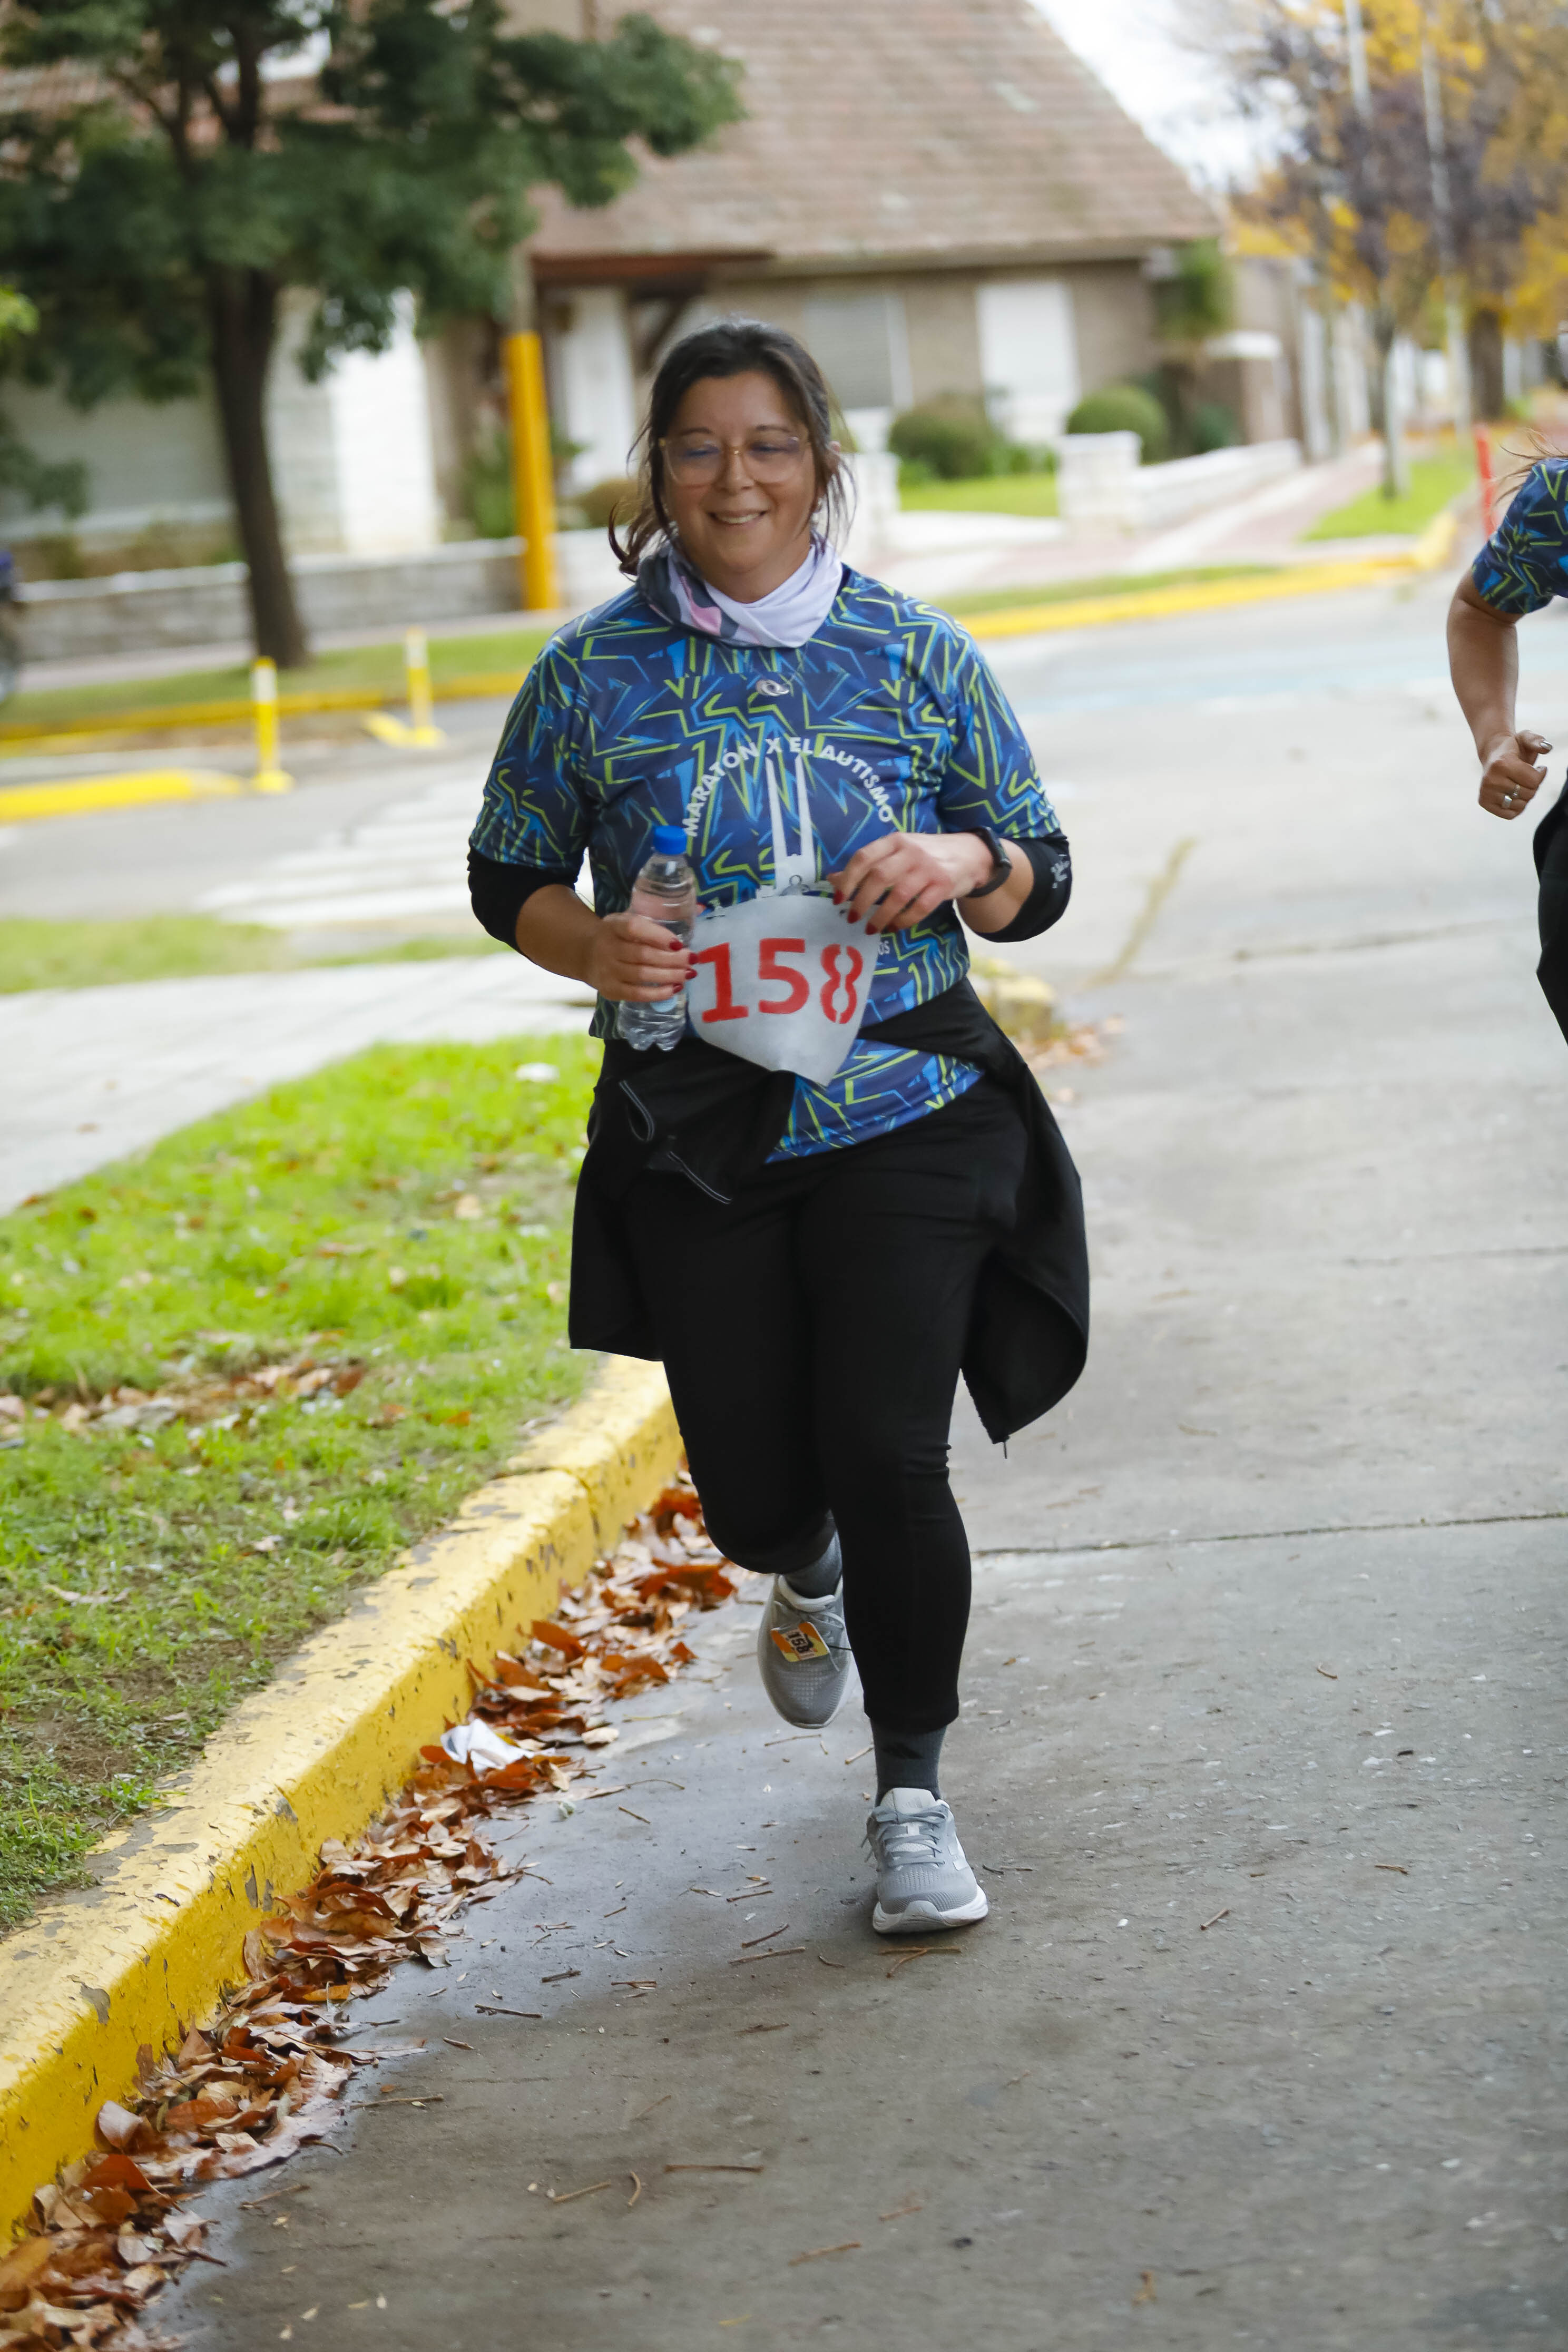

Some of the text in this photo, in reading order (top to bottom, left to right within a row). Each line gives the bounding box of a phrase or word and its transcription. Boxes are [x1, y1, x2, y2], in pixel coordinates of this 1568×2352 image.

[765, 737, 782, 754] X
[790, 737, 814, 754] EL
[819, 744, 893, 822] AUTISMO
[697, 938, 863, 1024] 158
[787, 1632, 810, 1653] 158
